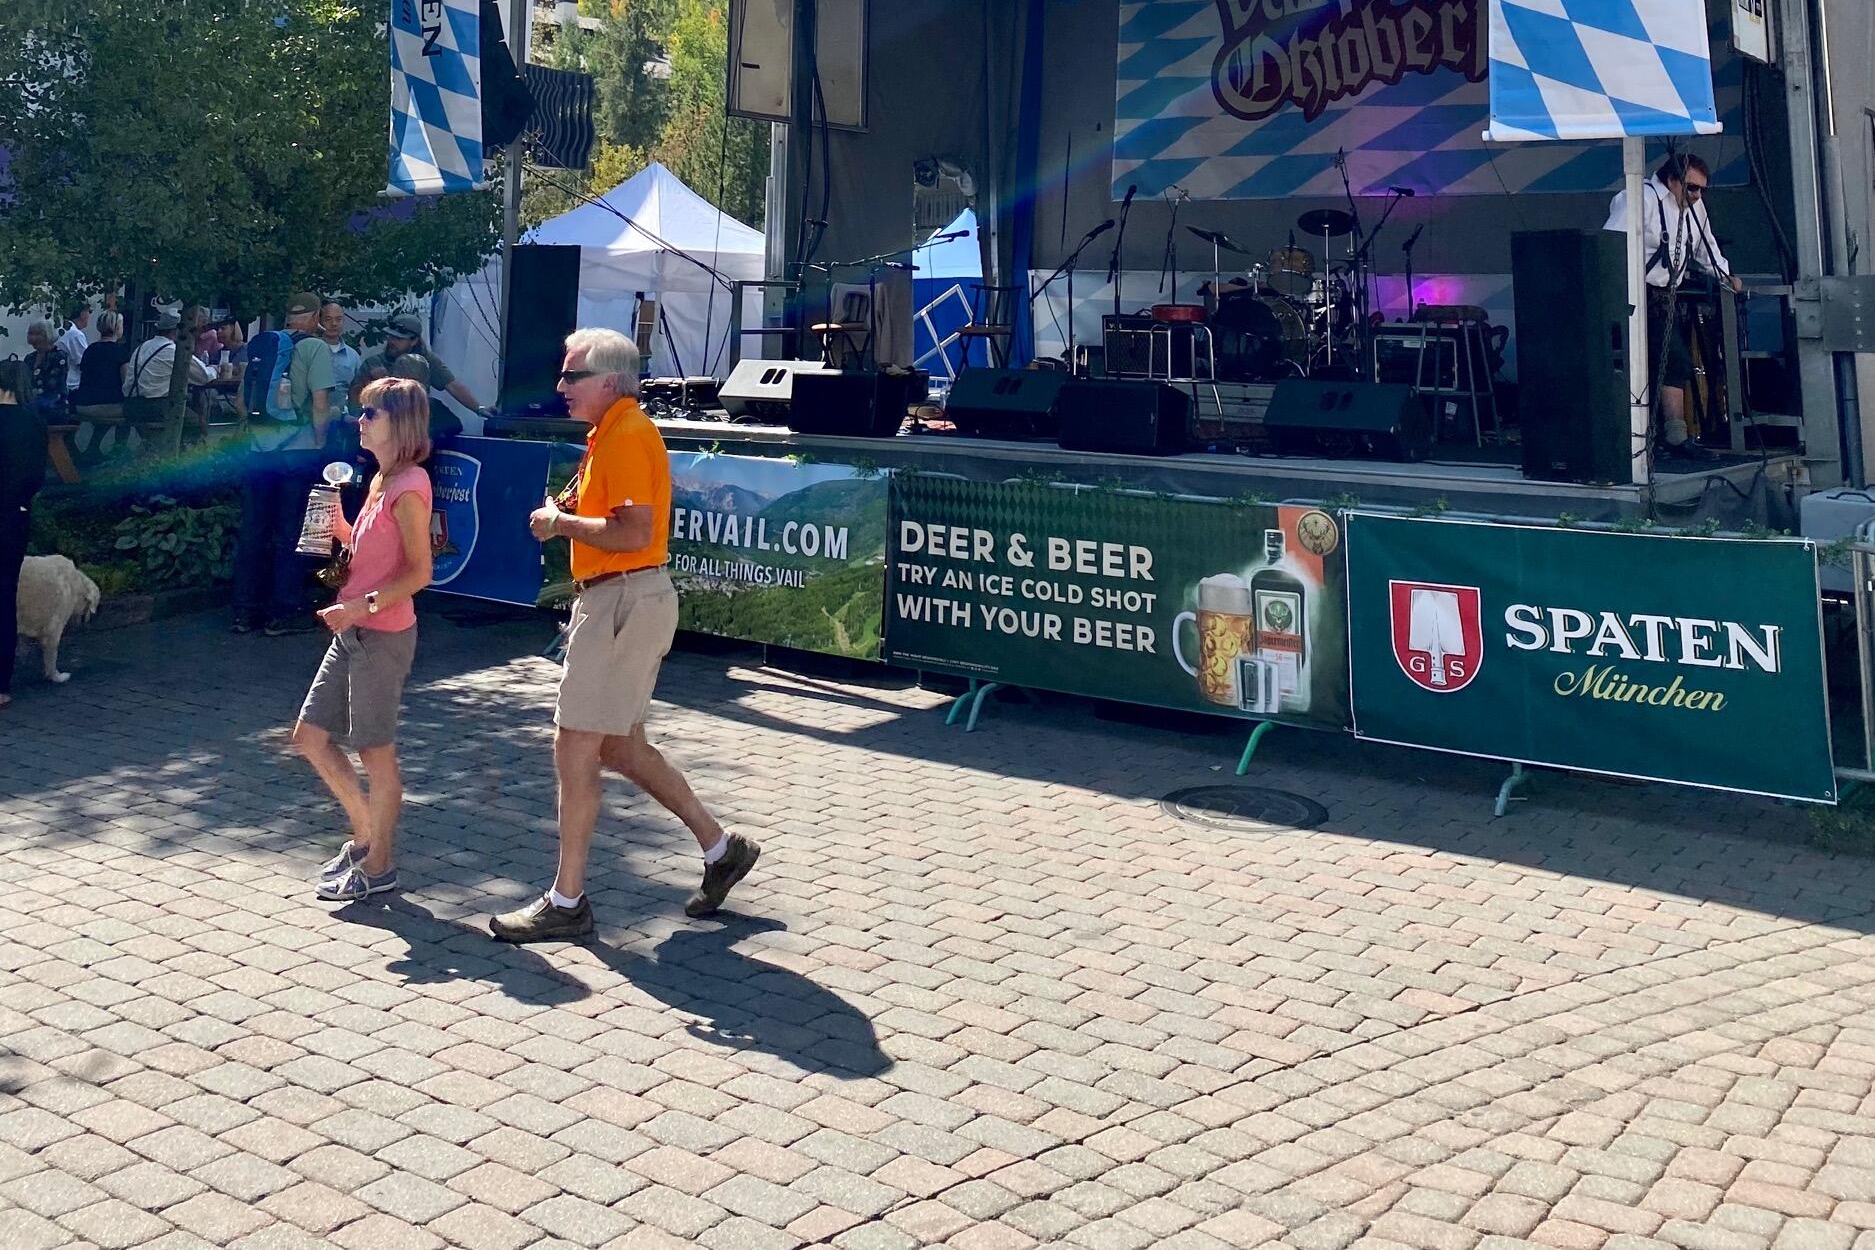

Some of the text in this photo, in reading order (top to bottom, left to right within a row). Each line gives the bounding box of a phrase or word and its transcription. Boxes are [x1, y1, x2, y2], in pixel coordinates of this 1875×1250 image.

[673, 507, 848, 560] ERVAIL.COM
[900, 520, 1155, 581] DEER & BEER
[675, 554, 697, 573] FOR
[699, 557, 722, 577] ALL
[724, 560, 773, 584] THINGS
[776, 567, 806, 588] VAIL
[898, 563, 1157, 614] TRY AN ICE COLD SHOT
[897, 593, 1156, 654] WITH YOUR BEER
[1504, 604, 1783, 673] SPATEN
[1554, 664, 1728, 711] München
